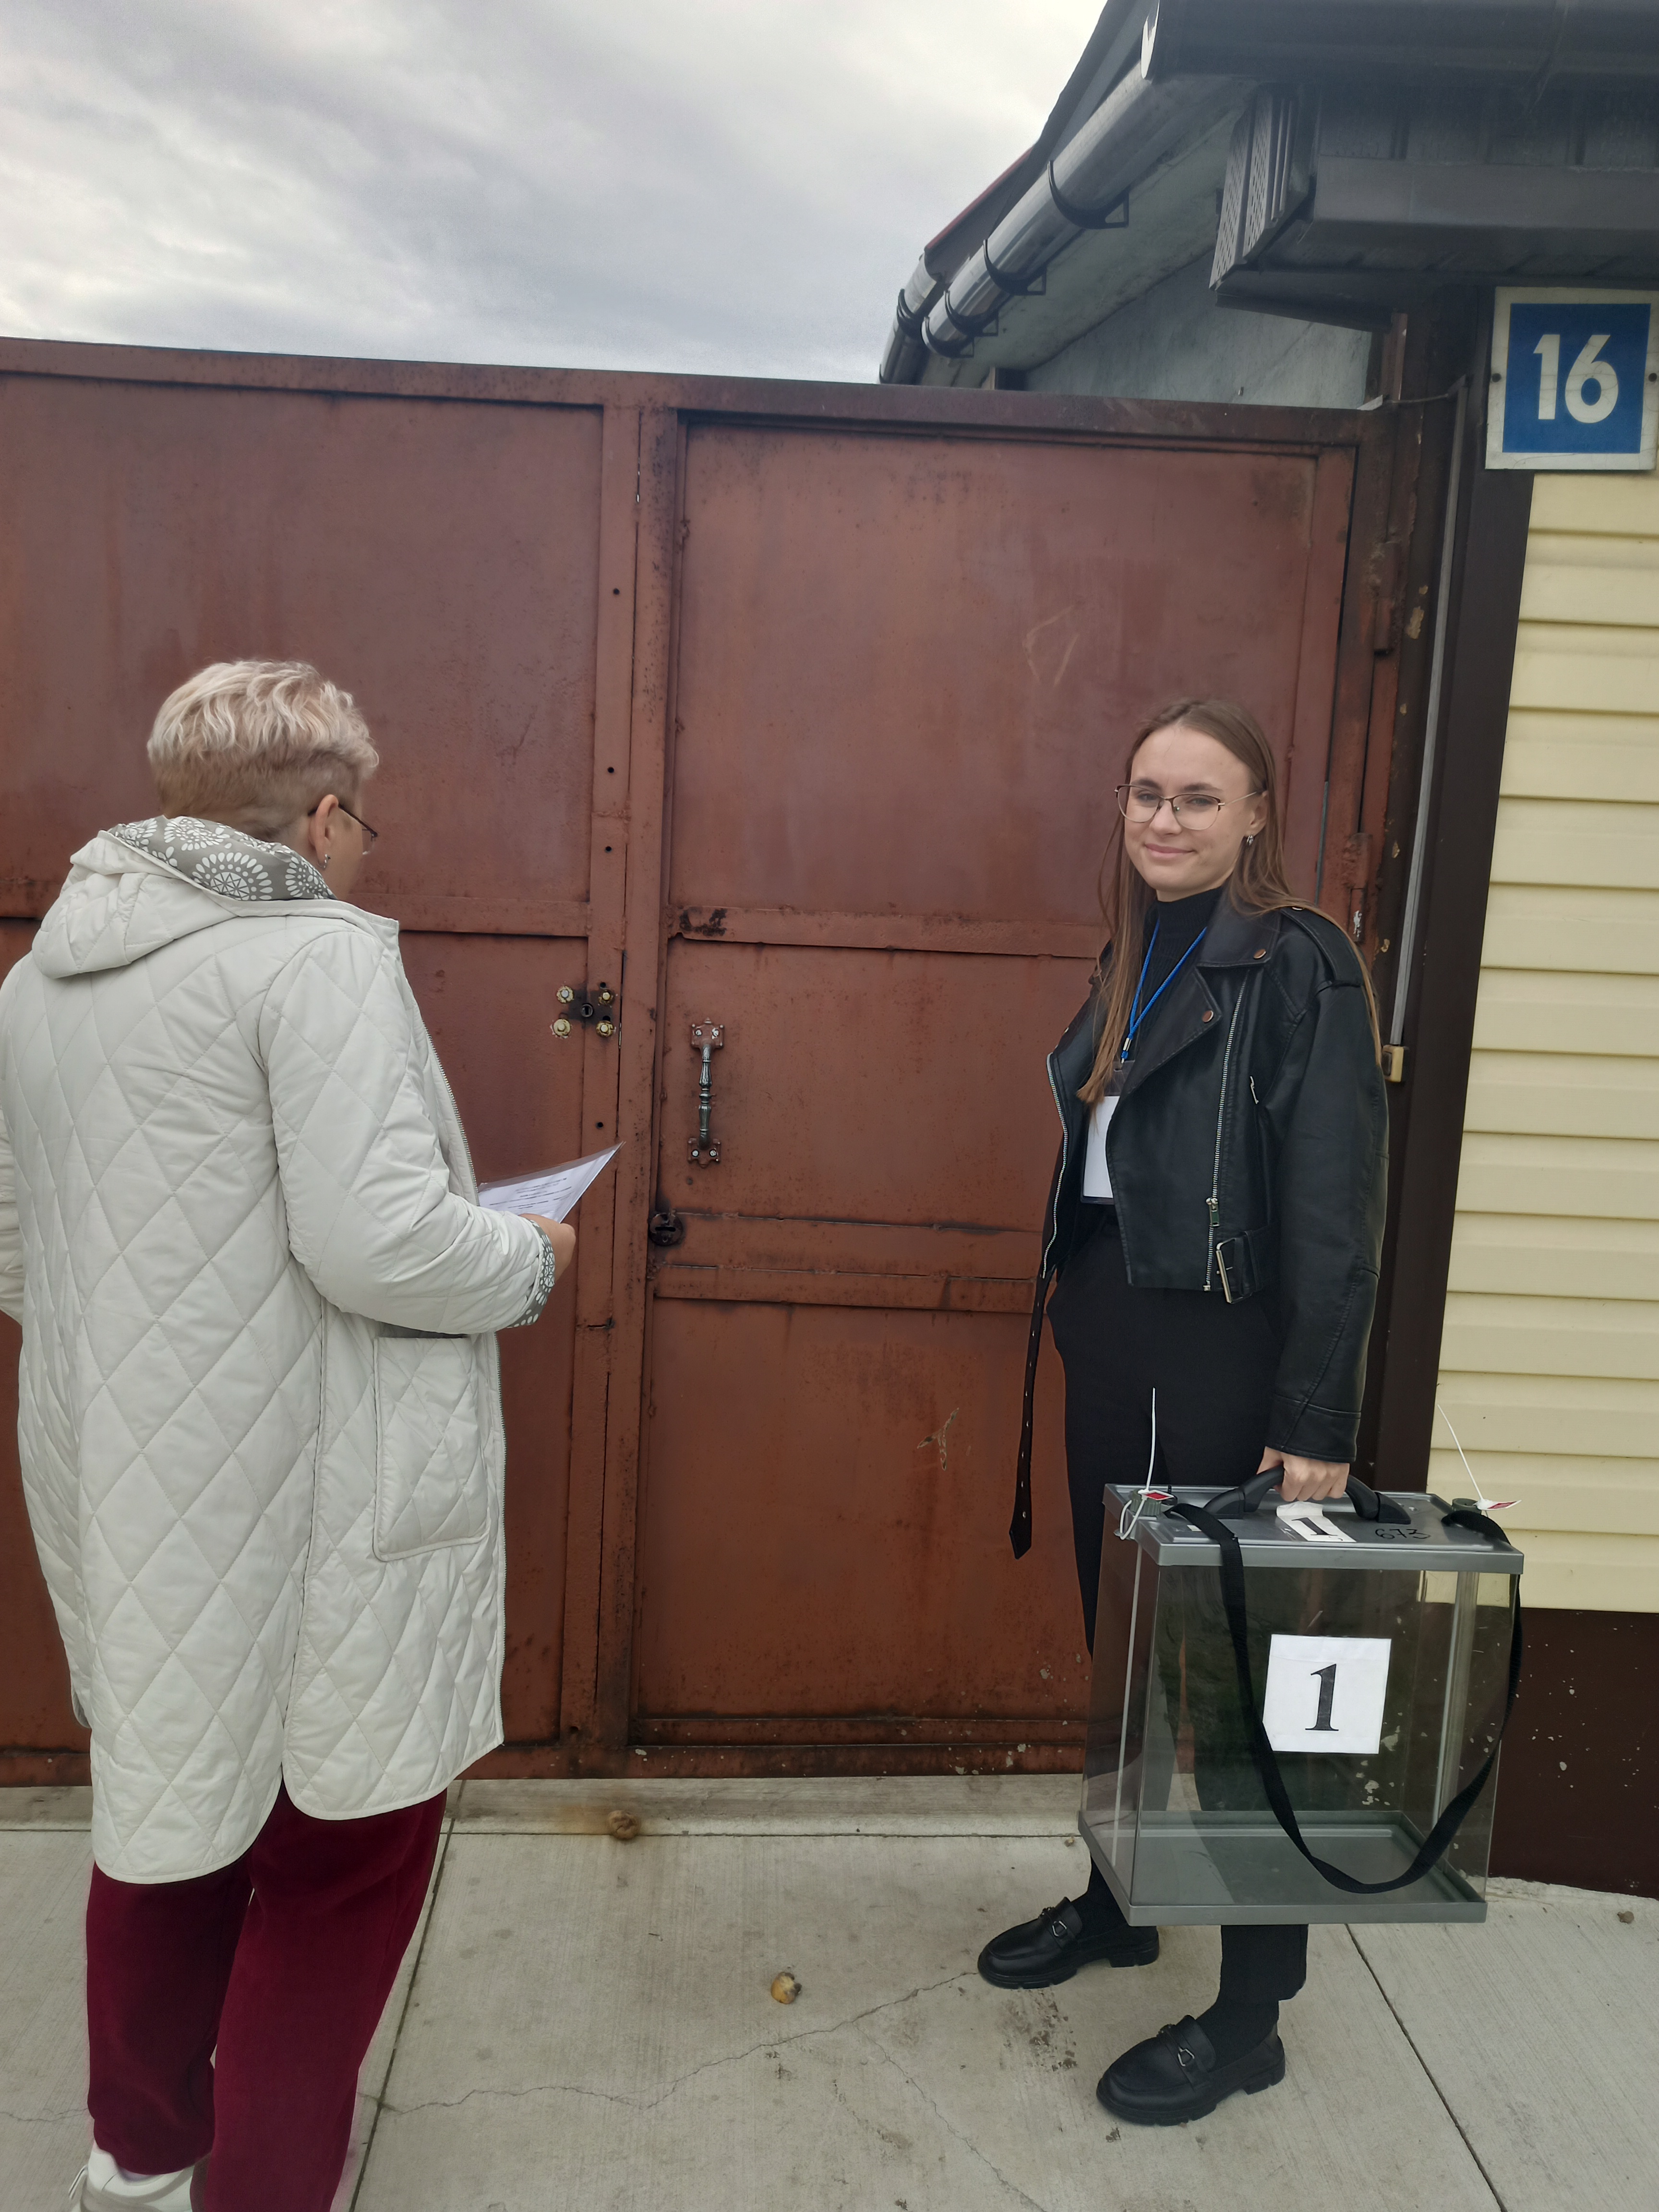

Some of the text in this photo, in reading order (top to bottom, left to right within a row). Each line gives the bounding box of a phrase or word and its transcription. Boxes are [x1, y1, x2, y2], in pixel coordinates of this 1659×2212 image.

[1533, 334, 1618, 423] 16
[1291, 1517, 1338, 1536] 1
[1375, 1528, 1431, 1539] 673
[1305, 1663, 1339, 1731] 1
